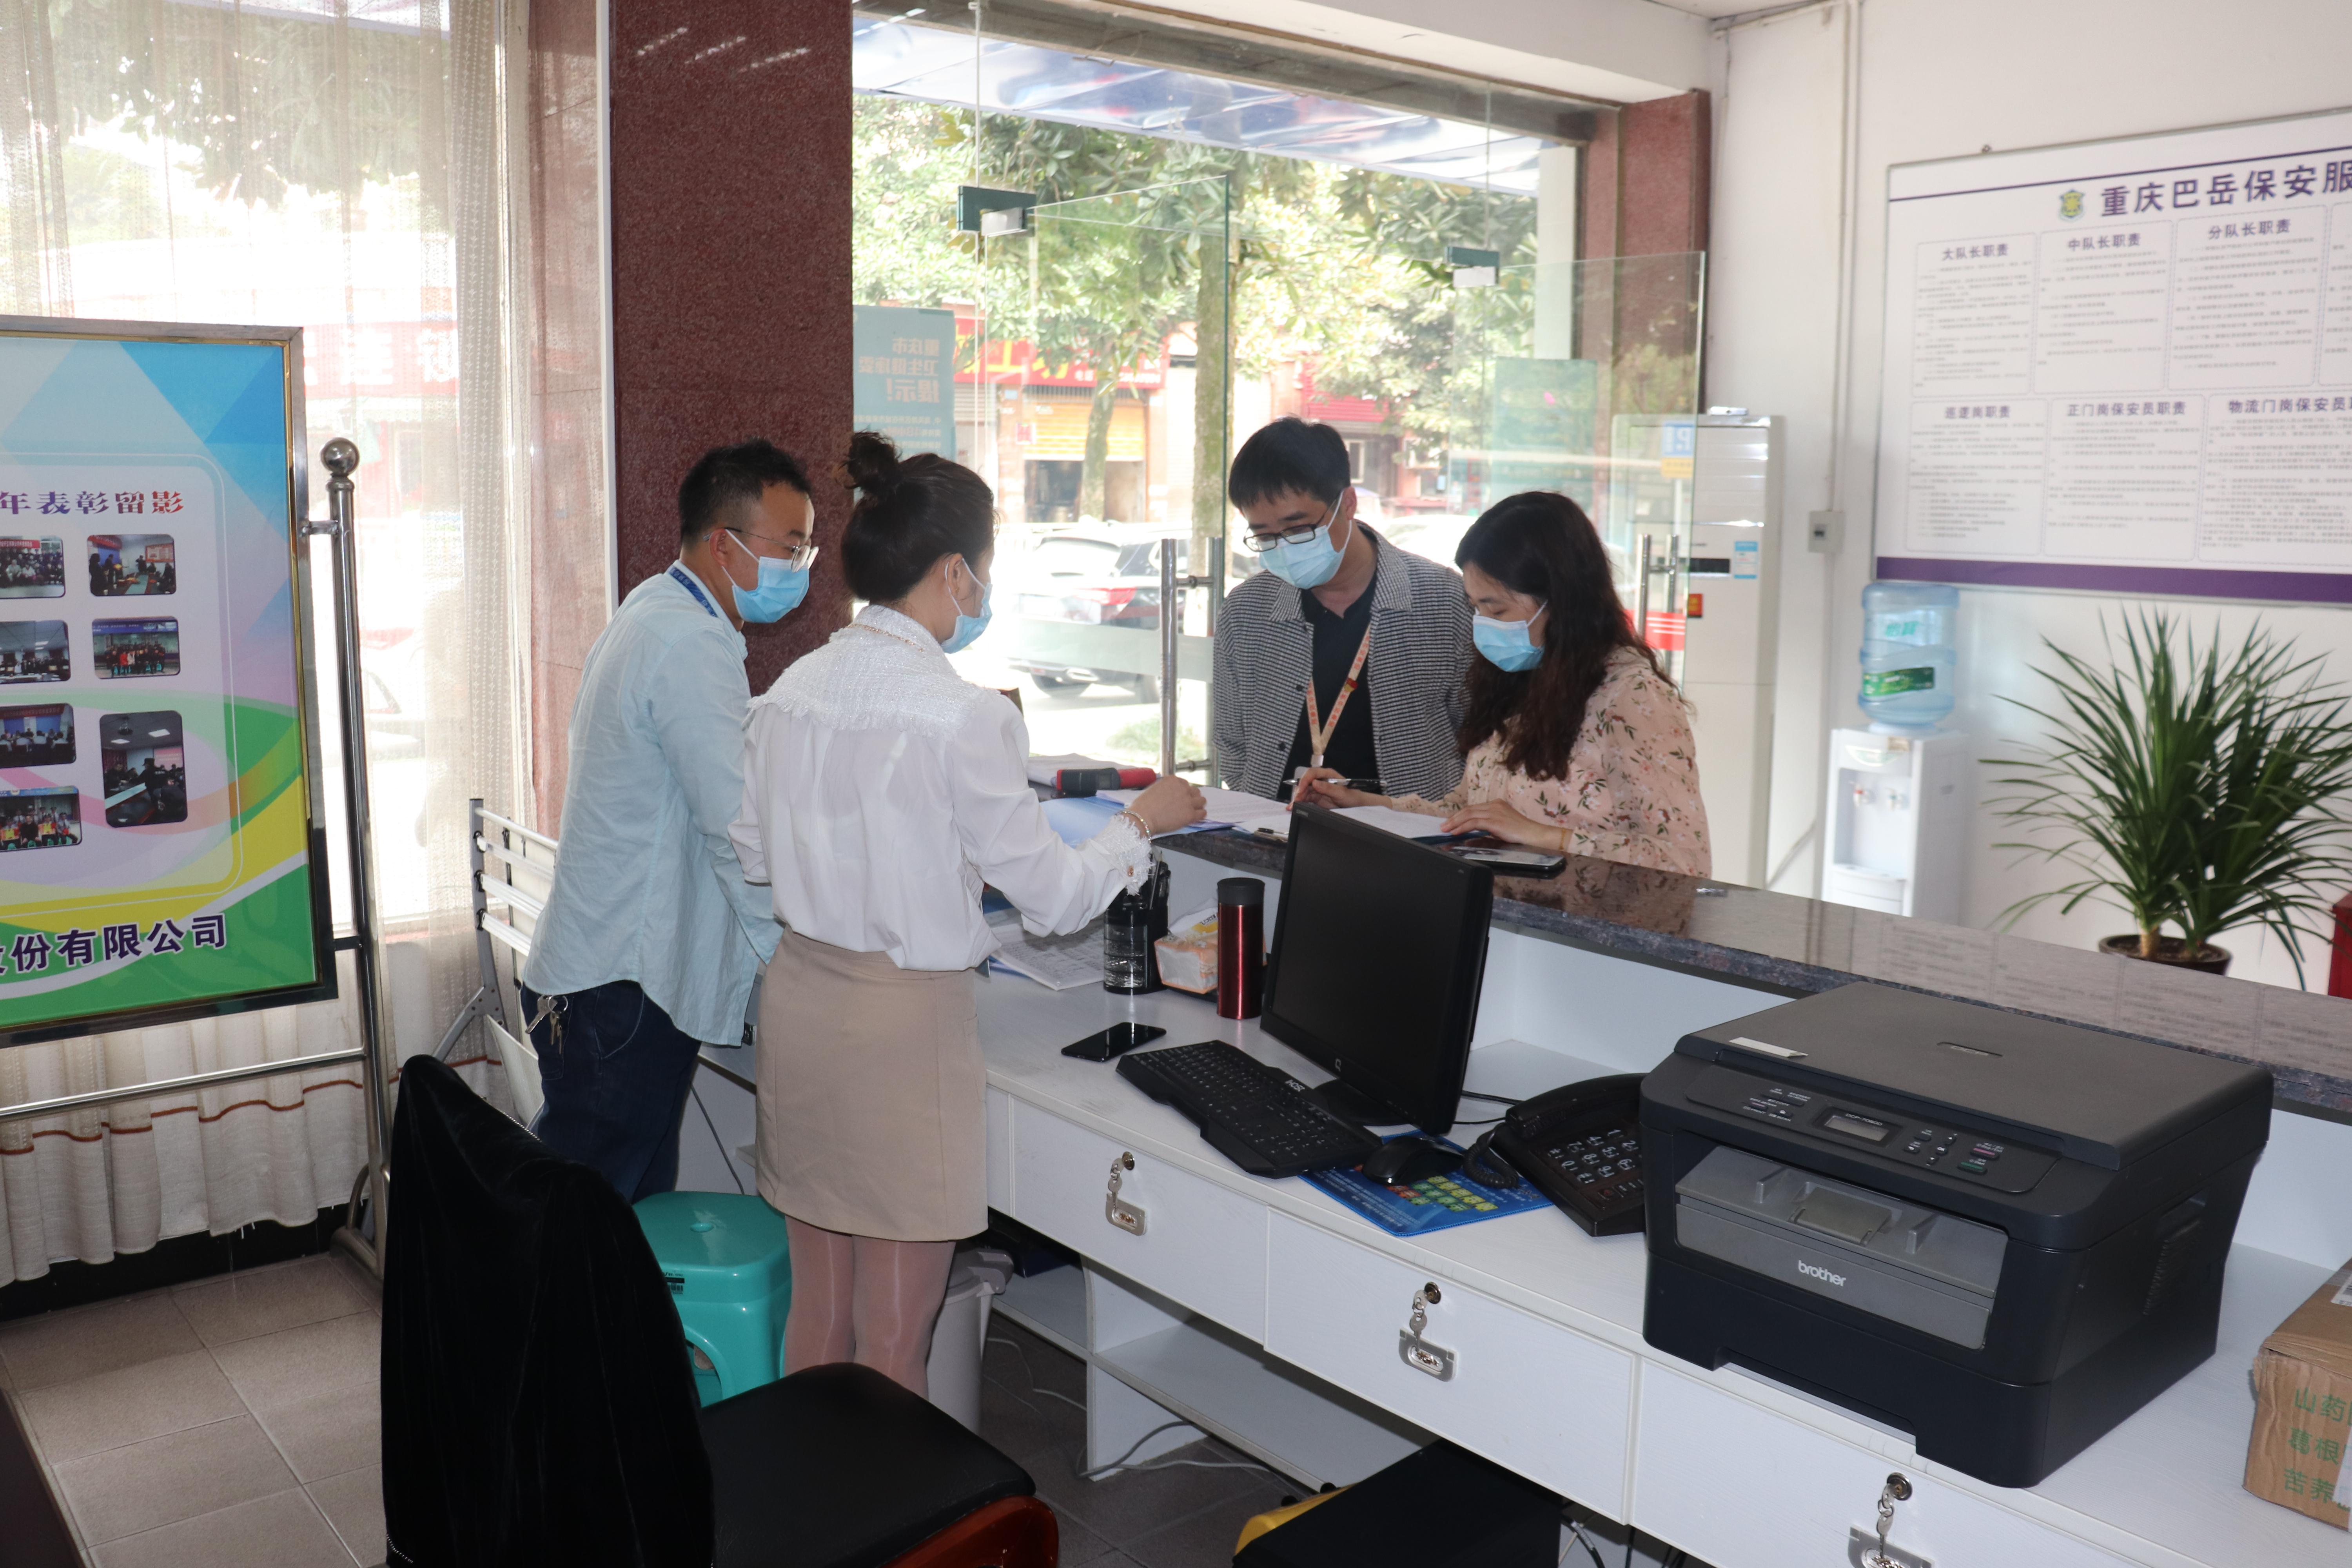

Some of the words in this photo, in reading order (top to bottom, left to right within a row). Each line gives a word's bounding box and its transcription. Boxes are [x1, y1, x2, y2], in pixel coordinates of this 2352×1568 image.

[2101, 160, 2352, 217] 重庆巴岳保安服
[2208, 219, 2291, 240] 分队长职责
[1942, 244, 2008, 261] 大队长职责
[2068, 233, 2141, 251] 中队长职责
[2067, 401, 2186, 416] 正门岗保安员职责
[2229, 397, 2352, 413] 物流门岗保安员
[0, 491, 184, 514] 年表彰留影
[0, 914, 226, 974] 份有限公司
[1798, 1259, 1846, 1287] brother
[2295, 1387, 2352, 1426] 山药
[2288, 1427, 2352, 1468] 葛根
